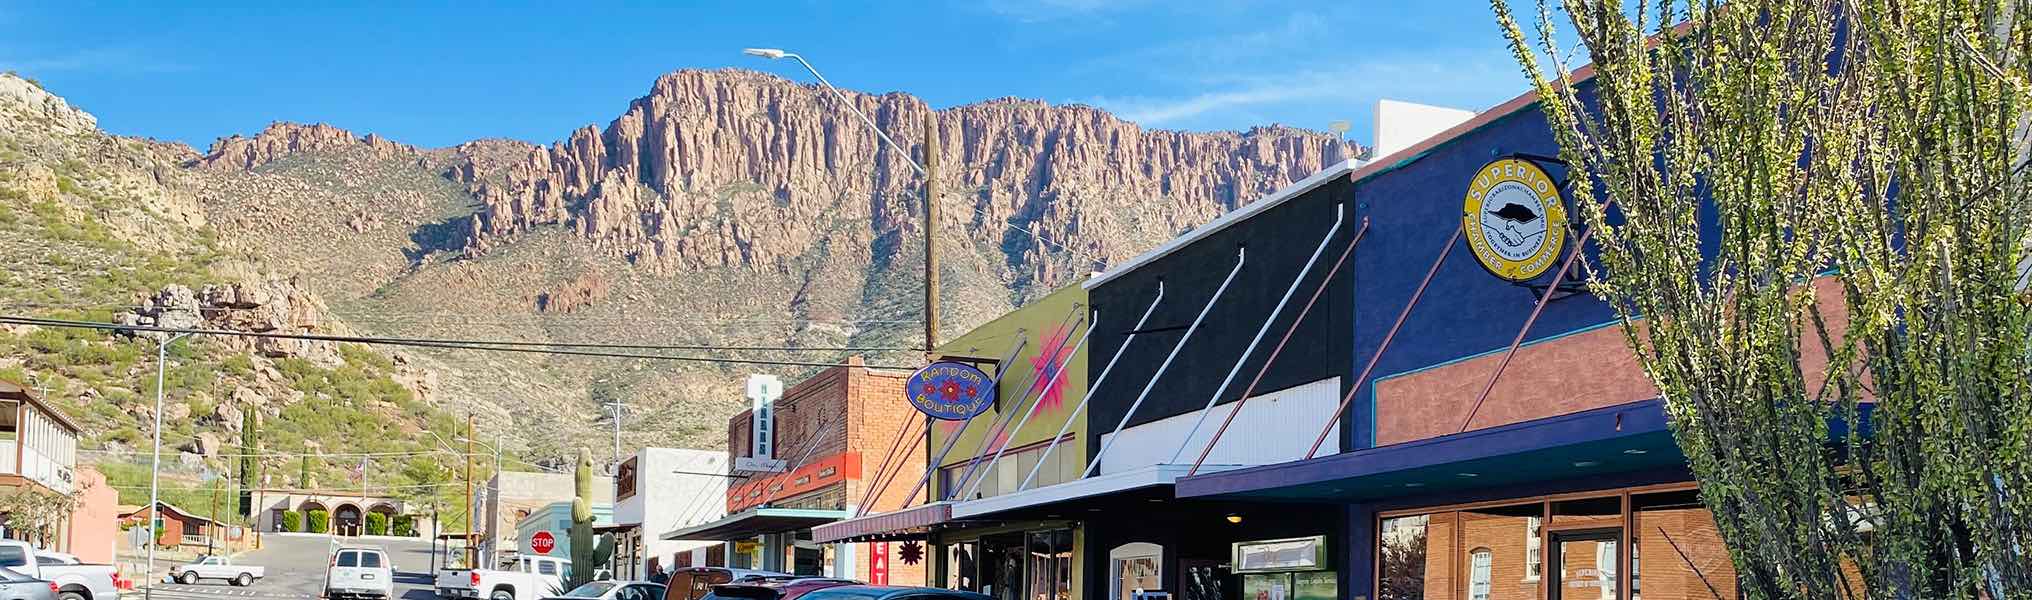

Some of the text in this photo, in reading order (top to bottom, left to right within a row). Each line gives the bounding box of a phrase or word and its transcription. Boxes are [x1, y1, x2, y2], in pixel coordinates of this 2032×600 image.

[1470, 164, 1558, 208] SUPERIOR
[1468, 212, 1504, 271] CHAMBER
[1519, 221, 1560, 273] COMMERCE
[920, 366, 982, 385] RANDOM
[532, 537, 554, 548] STOP
[876, 542, 885, 584] EAT
